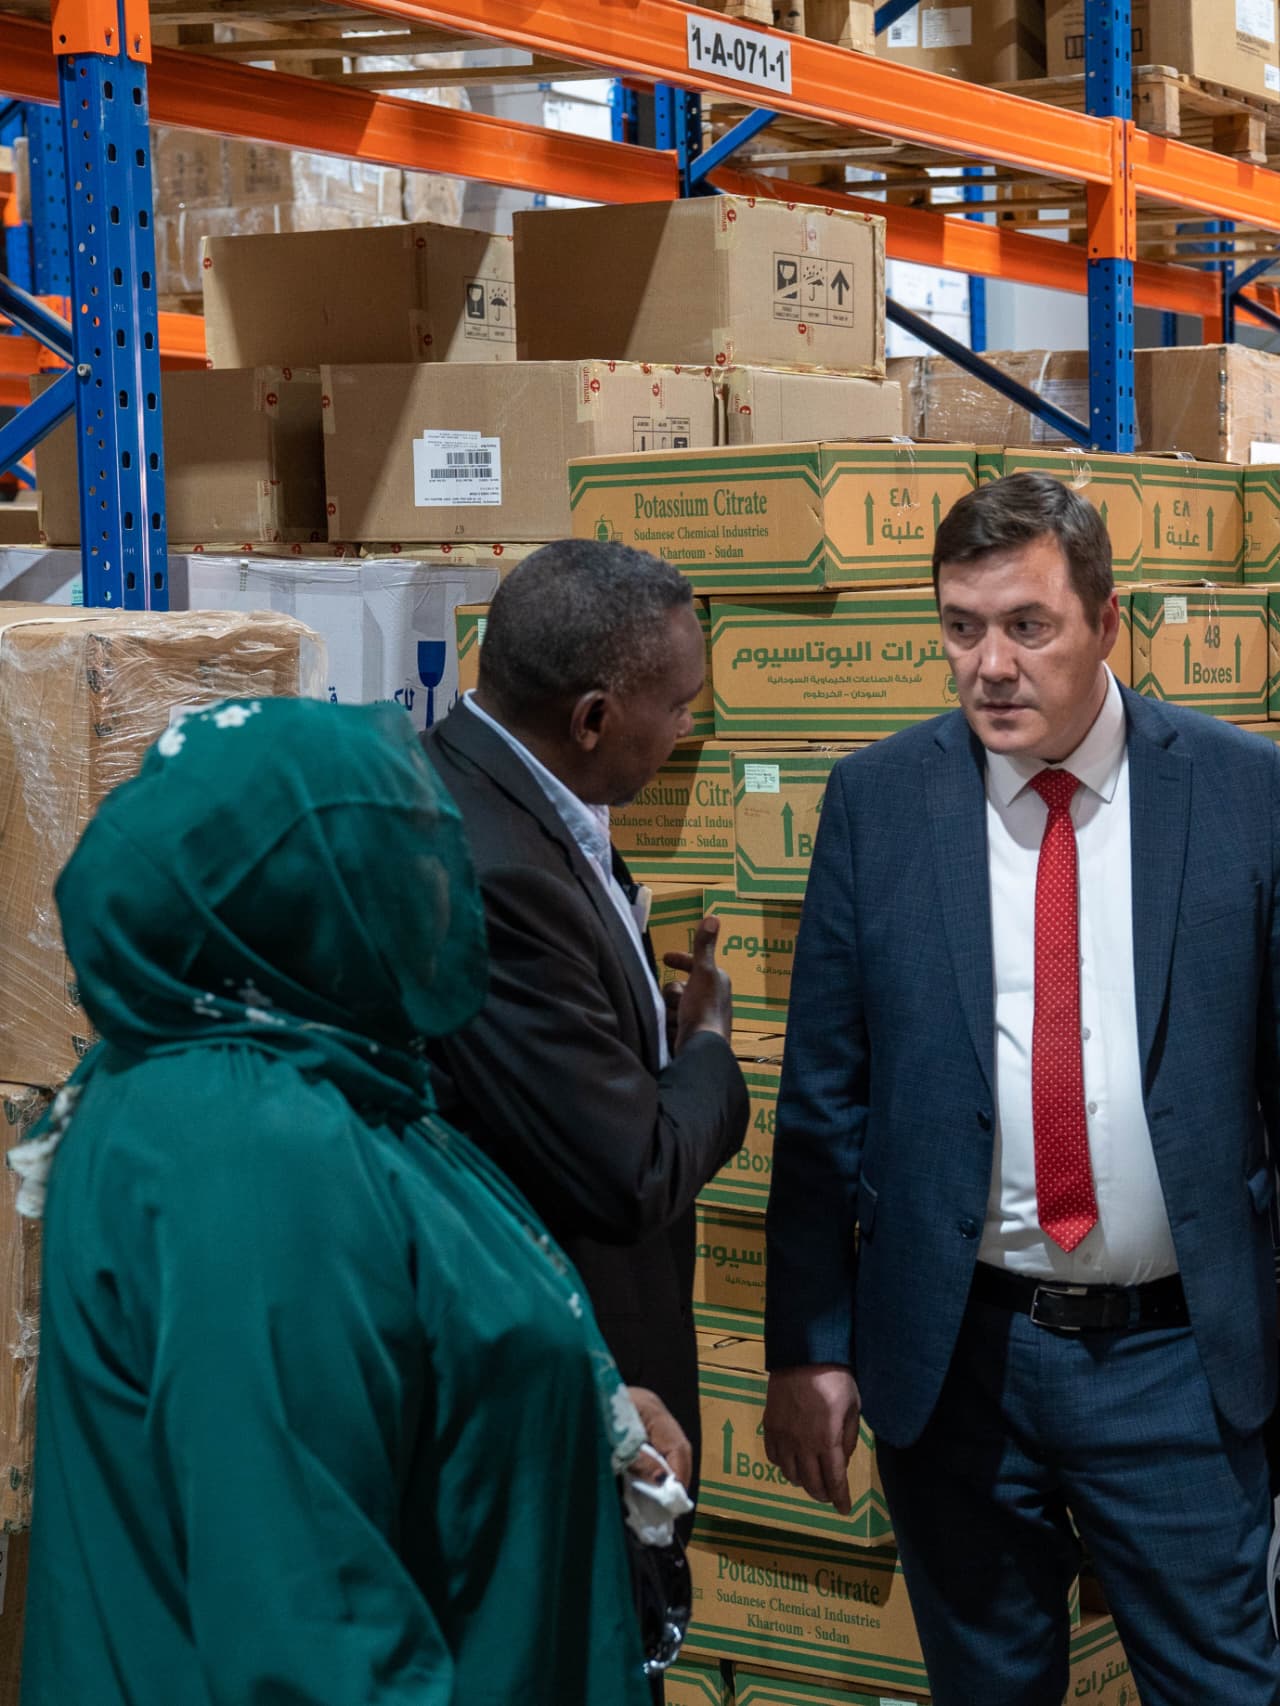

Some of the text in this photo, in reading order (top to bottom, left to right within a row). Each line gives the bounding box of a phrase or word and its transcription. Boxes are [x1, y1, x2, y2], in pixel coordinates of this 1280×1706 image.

[692, 26, 785, 82] 1-A-071-1
[633, 488, 768, 519] Potassium Citrate
[633, 524, 769, 541] Sudanese Chemical Industries
[882, 518, 924, 544] علبة
[1166, 525, 1200, 550] علبة
[660, 546, 706, 560] Khartoum
[715, 544, 744, 558] Sudan
[1204, 624, 1221, 649] 48
[732, 640, 946, 670] ترات البوتاسيوم
[1192, 662, 1232, 684] Boxes
[634, 779, 733, 807] assium Citr
[656, 814, 702, 828] Chemical
[705, 816, 733, 828] Indus
[636, 831, 688, 847] Khartoum
[696, 833, 729, 848] Sudan
[736, 1147, 772, 1174] Box
[737, 1452, 789, 1486] Boxe
[717, 1551, 880, 1606] Potassium Citrate
[716, 1588, 766, 1609] Sudanese
[769, 1597, 821, 1619] Chemical
[824, 1607, 881, 1629] Industries
[747, 1613, 804, 1636] Khartoum
[815, 1625, 850, 1644] Sudan
